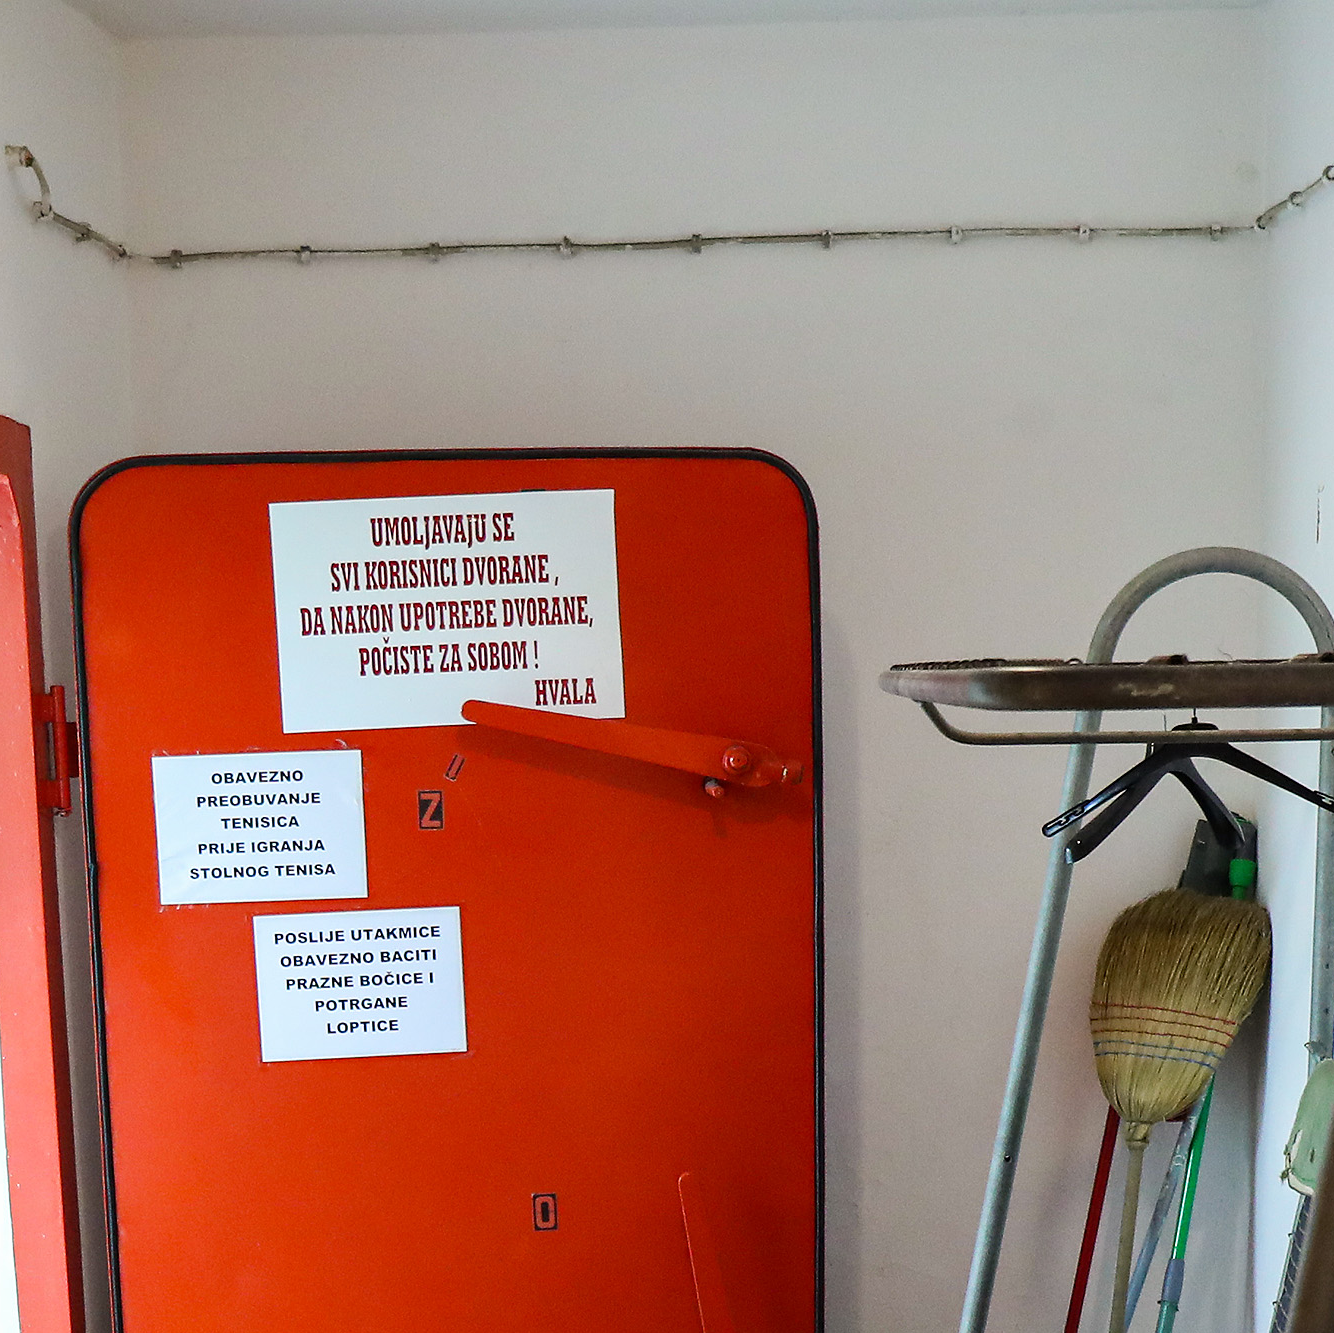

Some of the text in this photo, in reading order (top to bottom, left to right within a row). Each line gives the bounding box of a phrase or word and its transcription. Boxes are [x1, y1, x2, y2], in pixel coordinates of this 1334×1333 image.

[369, 512, 515, 551] UMOLJAVAJU SE
[330, 561, 361, 593] SVI
[364, 557, 458, 591] KORISNICI
[461, 554, 550, 586] DVORANE
[299, 595, 594, 637] DA NAKON UPOTREBE DVORANE,
[358, 636, 435, 677] POČISTE
[438, 643, 463, 673] ZA
[467, 640, 528, 672] SOBOM
[534, 677, 597, 707] HVALA
[211, 770, 304, 785] OBAVEZNO
[196, 792, 321, 808] PREOBUVANJE
[419, 792, 442, 828] Z
[220, 815, 300, 830] TENISICA
[198, 839, 325, 855] PRIJE IGRANJA
[190, 863, 336, 880] STOLNOG TENISA
[274, 925, 441, 945] POSLIJE UTAKMICE
[280, 948, 437, 968] OBAVEZNO BACITI
[286, 971, 434, 991] PRAZNE BOČICE I
[315, 996, 408, 1012] POTRGANE
[327, 1019, 399, 1034] LOPTICE
